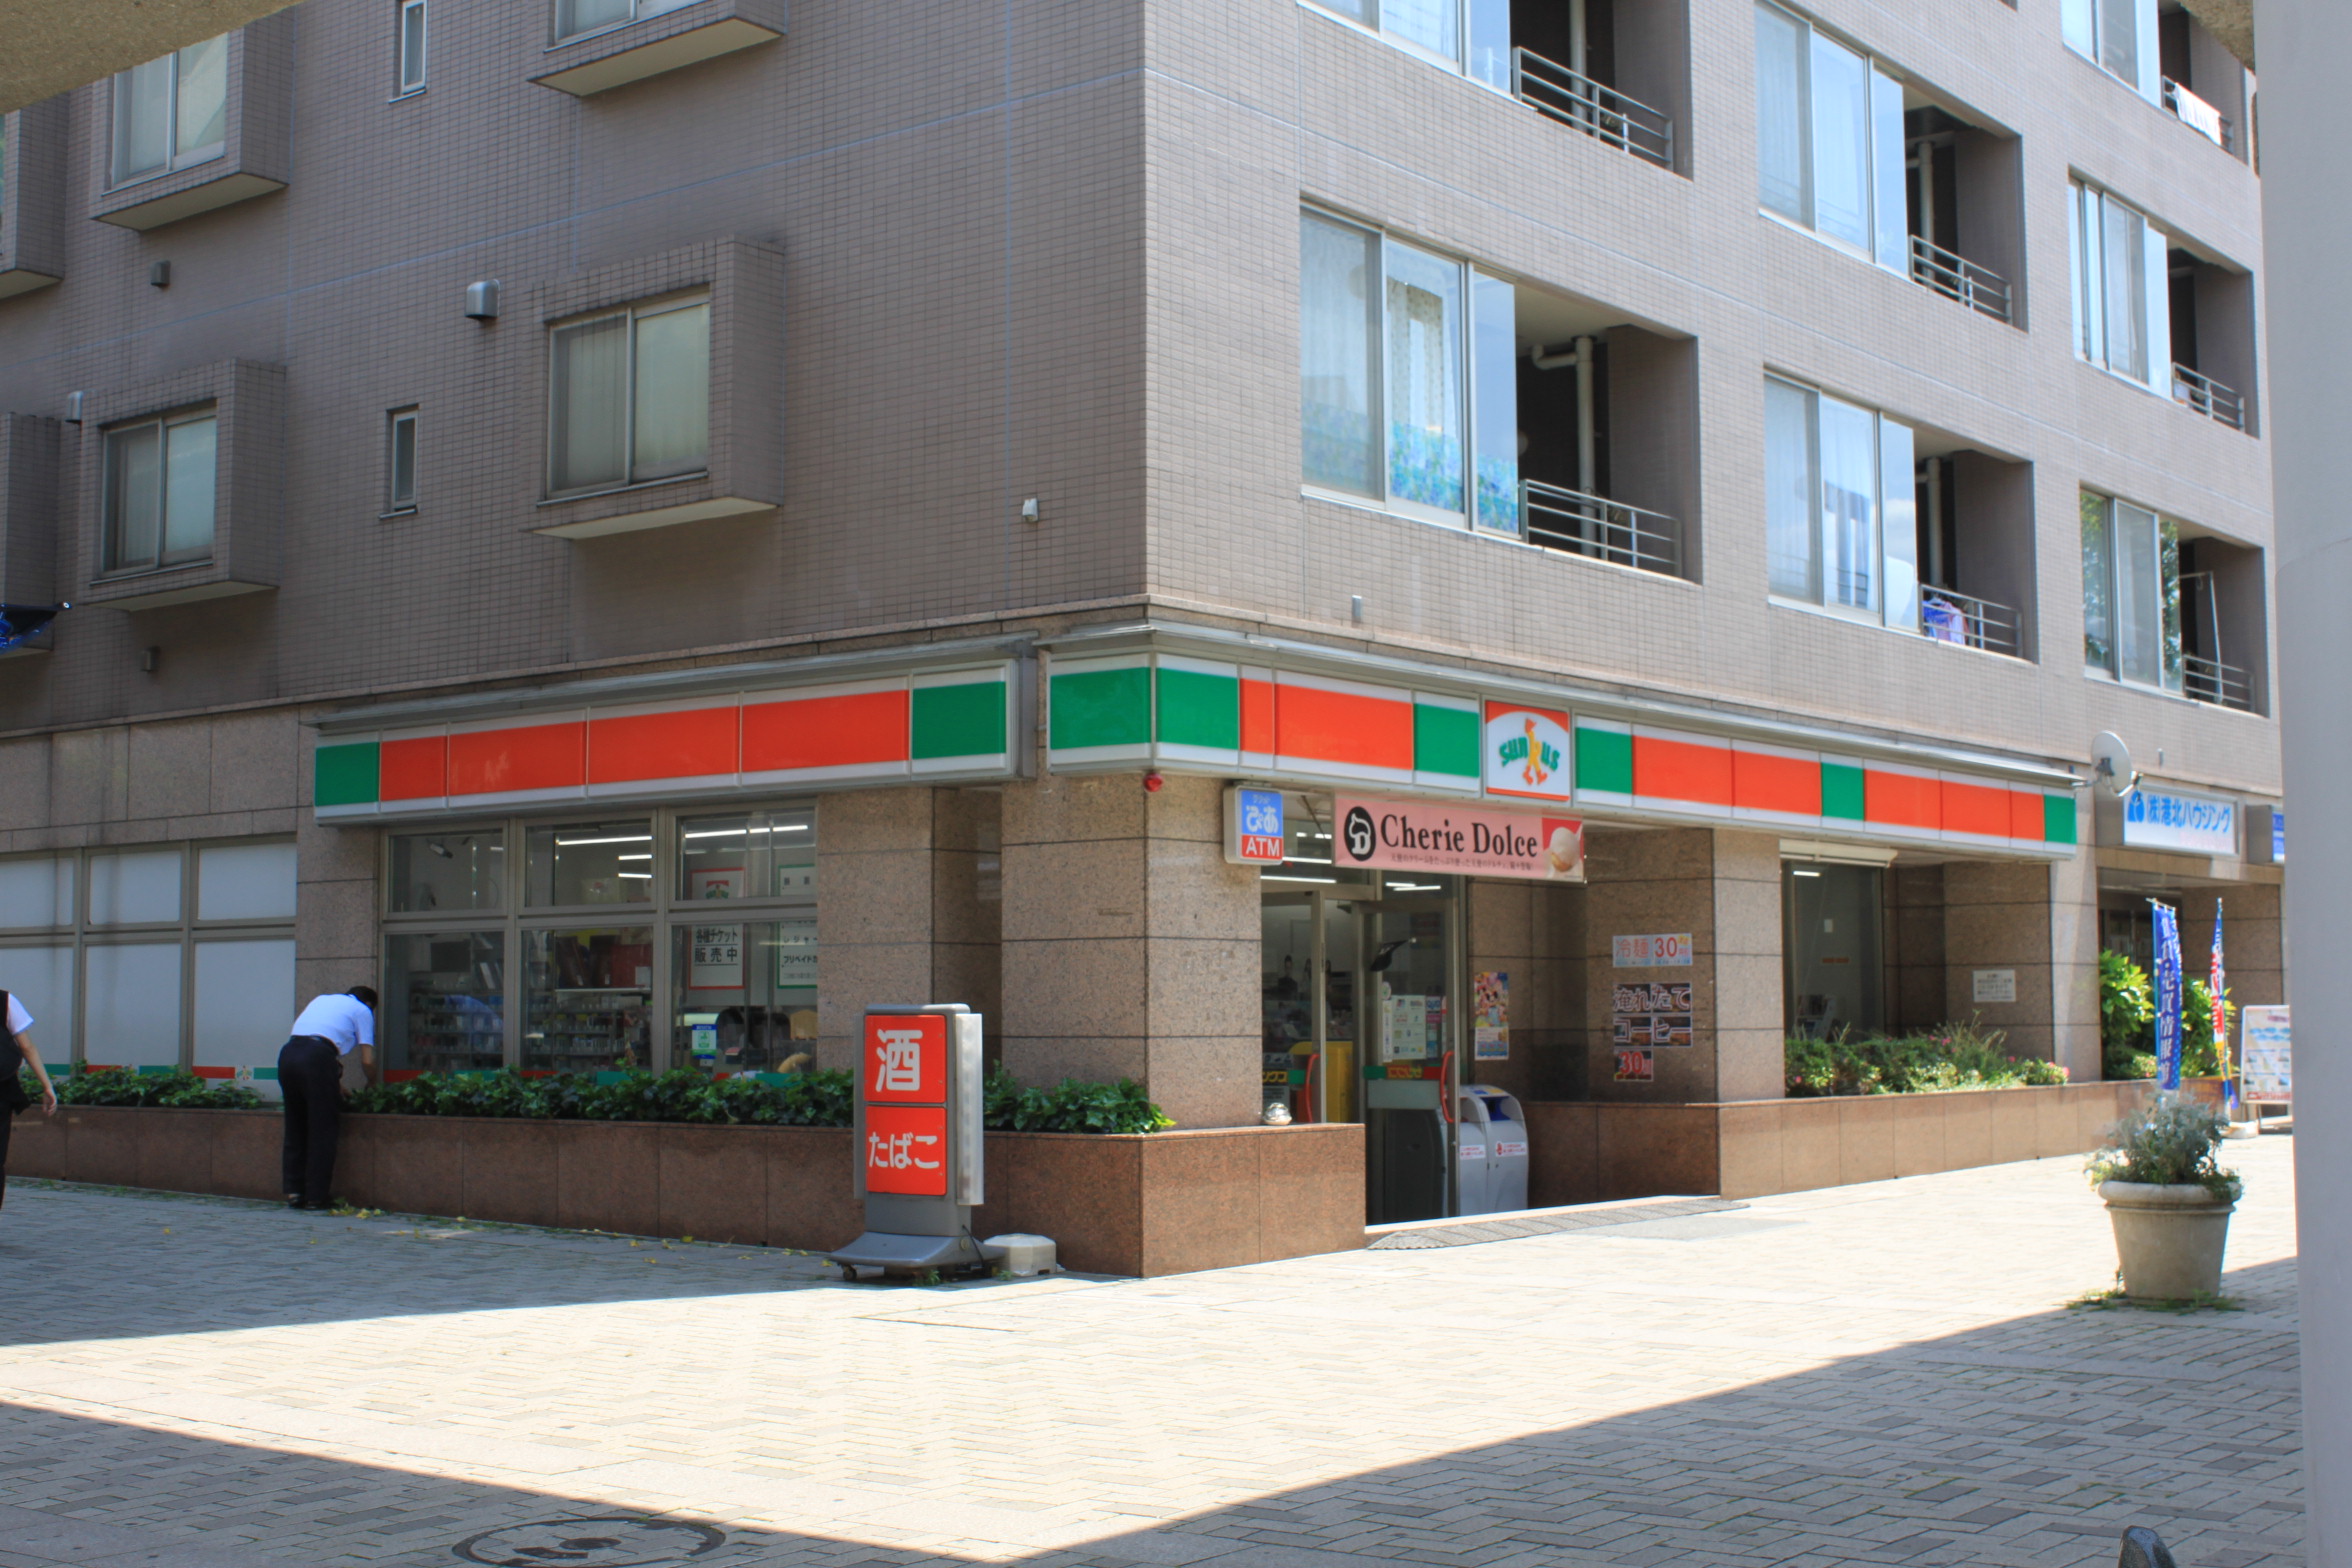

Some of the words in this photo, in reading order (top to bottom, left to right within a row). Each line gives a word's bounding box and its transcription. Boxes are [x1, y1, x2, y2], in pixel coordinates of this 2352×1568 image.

[1246, 805, 1279, 834] ぴあ
[1246, 837, 1280, 857] ATM
[1380, 813, 1464, 853] Cherie
[1472, 822, 1538, 857] Dolce
[696, 927, 738, 943] 各種チケット
[694, 947, 738, 963] 販売中
[1654, 937, 1677, 958] 30
[1614, 1018, 1691, 1043] コーヒー
[875, 1028, 923, 1092] 酒
[1619, 1051, 1644, 1074] 30
[868, 1131, 940, 1169] たばこ
